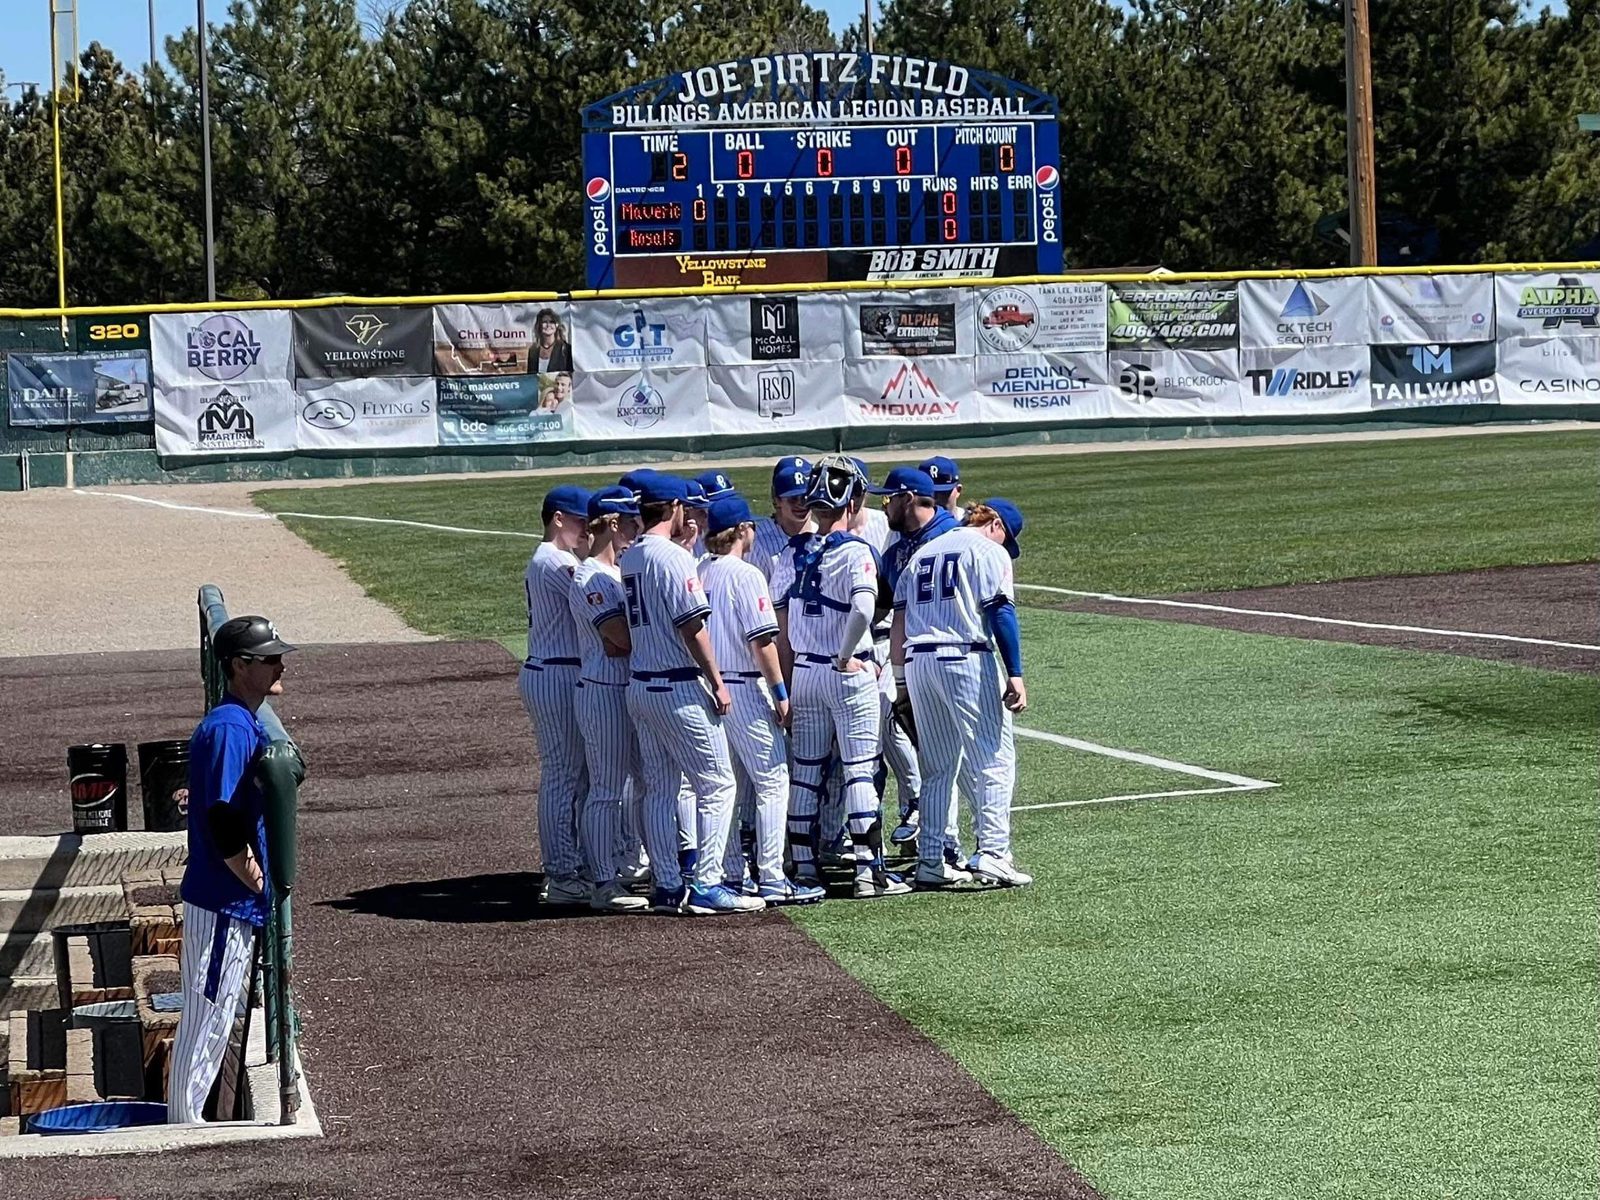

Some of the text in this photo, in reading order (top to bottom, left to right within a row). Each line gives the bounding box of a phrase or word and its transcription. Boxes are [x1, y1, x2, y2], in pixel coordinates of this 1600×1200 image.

[678, 53, 969, 103] JOE PIRTZ FIELD
[613, 97, 1030, 125] BILLINGS AMERICAN LEGION BASEBALL
[641, 135, 678, 152] TIME
[725, 133, 764, 150] BALL
[796, 131, 851, 149] STRIKE
[887, 129, 918, 146] OUT
[955, 127, 1017, 145] PITCH COUNT
[673, 153, 687, 179] 2
[738, 151, 753, 178] 0
[817, 149, 832, 176] 0
[896, 147, 911, 174] 0
[1000, 145, 1014, 172] 0
[696, 175, 1033, 198] 1 2 3 4 5 6 7 8 9 10 RUNS HITS ERR
[694, 200, 705, 220] 0
[943, 192, 956, 214] 0
[1039, 192, 1058, 242] pepsi
[590, 205, 609, 256] pepsi
[944, 218, 956, 240] 0
[869, 247, 999, 271] BOB SMITH
[1112, 290, 1237, 302] PERFORMANCE
[1520, 287, 1599, 305] ALPHA
[1137, 301, 1213, 310] AUTO SALES
[1521, 306, 1595, 315] OVERHEAD DOOR
[899, 313, 940, 326] ALPHA
[1152, 313, 1173, 321] SELL
[1177, 312, 1217, 321] CONSIGN
[90, 323, 139, 340] 320
[458, 329, 526, 339] Chris Dunn
[896, 327, 939, 337] EXTERIORS
[1112, 323, 1236, 337] 406CARS.COM
[1277, 321, 1333, 333] CK TECH
[1277, 335, 1332, 345] SECURITY
[187, 347, 261, 367] BERRY
[324, 349, 405, 361] YELLOWSTONE
[759, 345, 792, 354] HOMES
[1005, 365, 1077, 379] DENNY
[1293, 369, 1363, 390] RIDLEY
[440, 381, 520, 391] Smile makeovers
[762, 376, 791, 401] RSO
[992, 377, 1090, 393] MENHOLT
[1164, 375, 1228, 388] BLACKROCK
[1372, 379, 1495, 400] TAILWIND
[1520, 378, 1600, 393] CASINO
[440, 391, 494, 402] just for you
[1013, 395, 1071, 409] NISSAN
[363, 401, 413, 415] FLYING
[420, 400, 430, 413] S
[617, 406, 666, 417] KNOCKOUT
[860, 401, 960, 416] MIDWAY
[460, 419, 487, 432] bdc
[206, 433, 246, 441] MARTIN
[794, 472, 805, 485] R
[930, 465, 938, 478] R
[917, 551, 962, 604] 20
